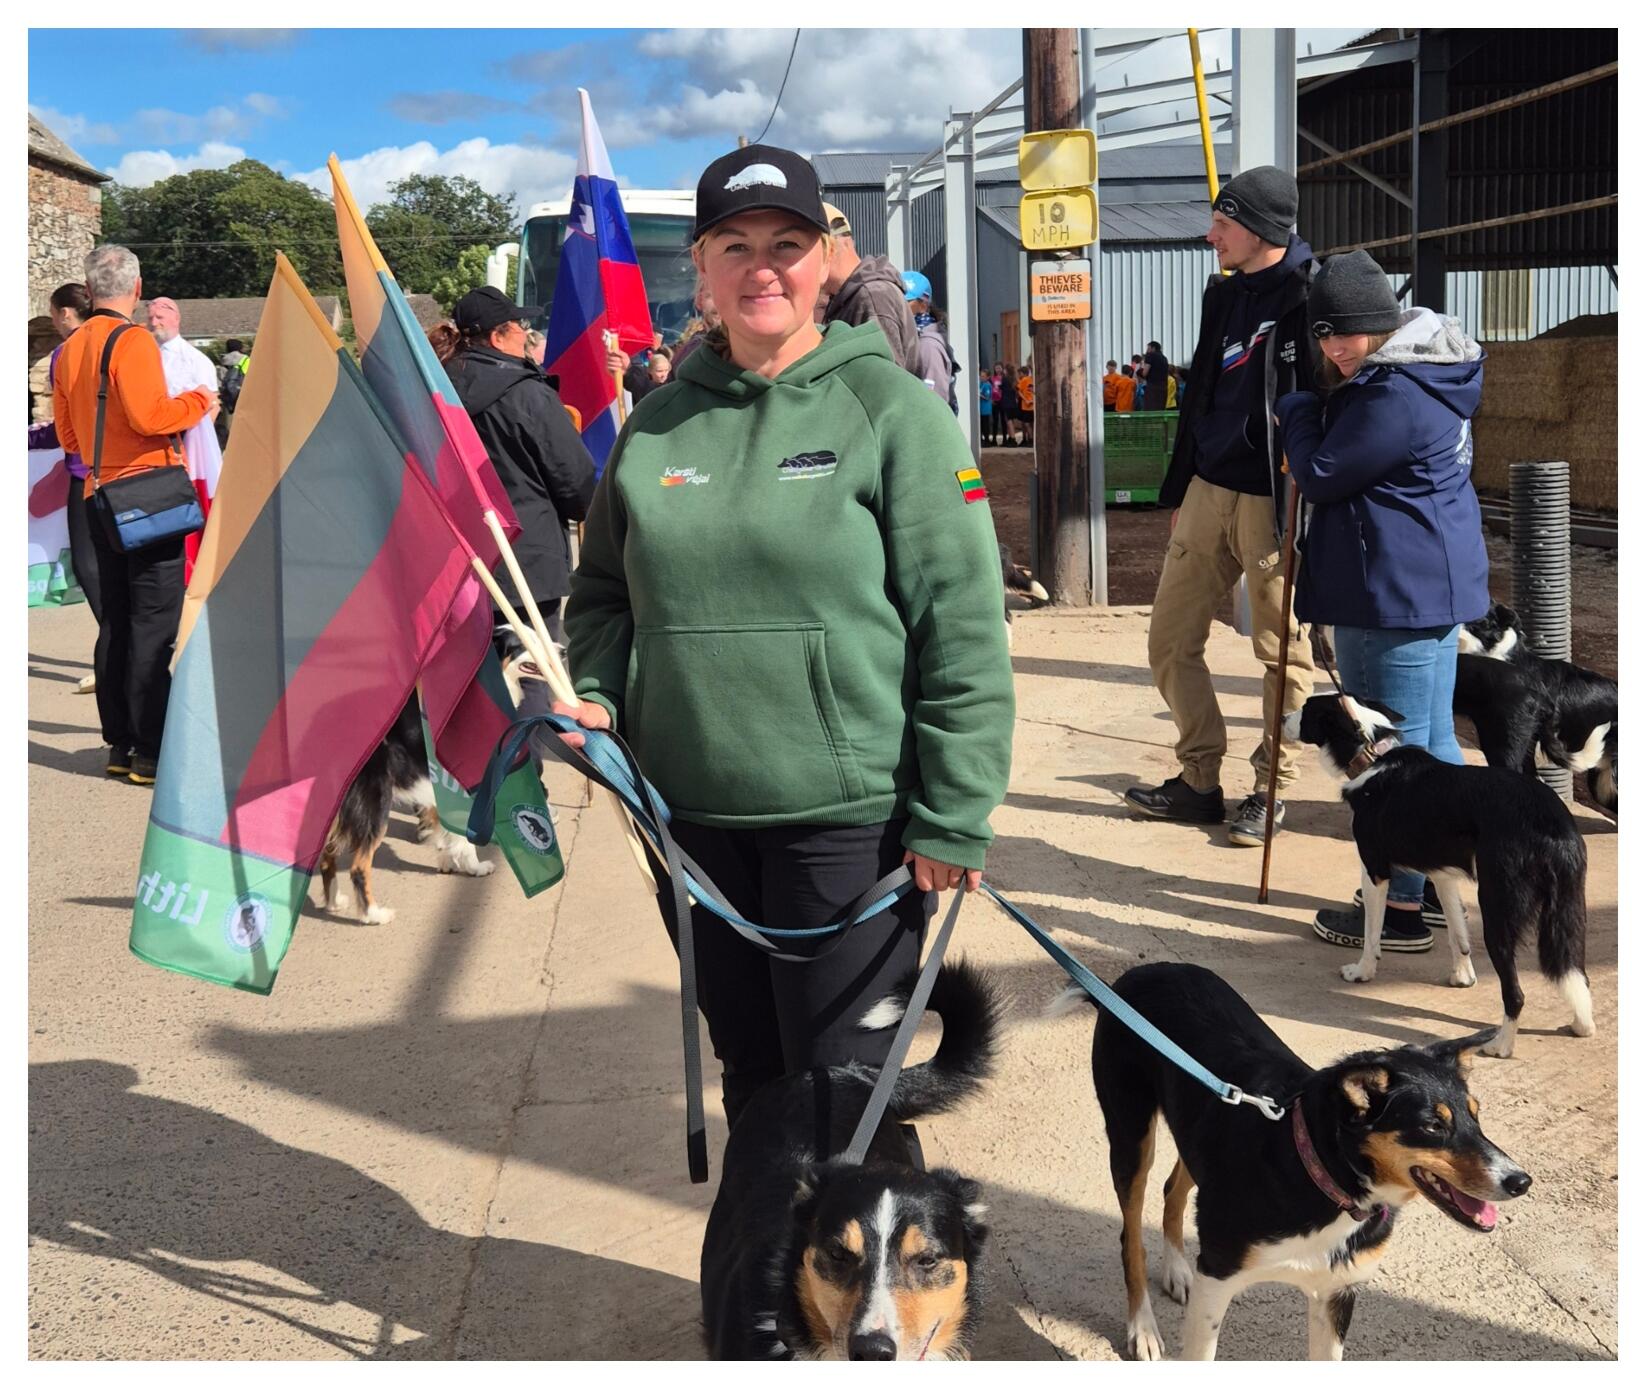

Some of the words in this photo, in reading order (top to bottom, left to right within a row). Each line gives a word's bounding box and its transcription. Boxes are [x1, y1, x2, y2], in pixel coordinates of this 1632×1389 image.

[1039, 202, 1065, 224] 10
[1033, 225, 1069, 243] MPH
[1040, 274, 1082, 284] THIEVES
[1040, 283, 1083, 294] BEWARE
[1326, 931, 1365, 946] croc
